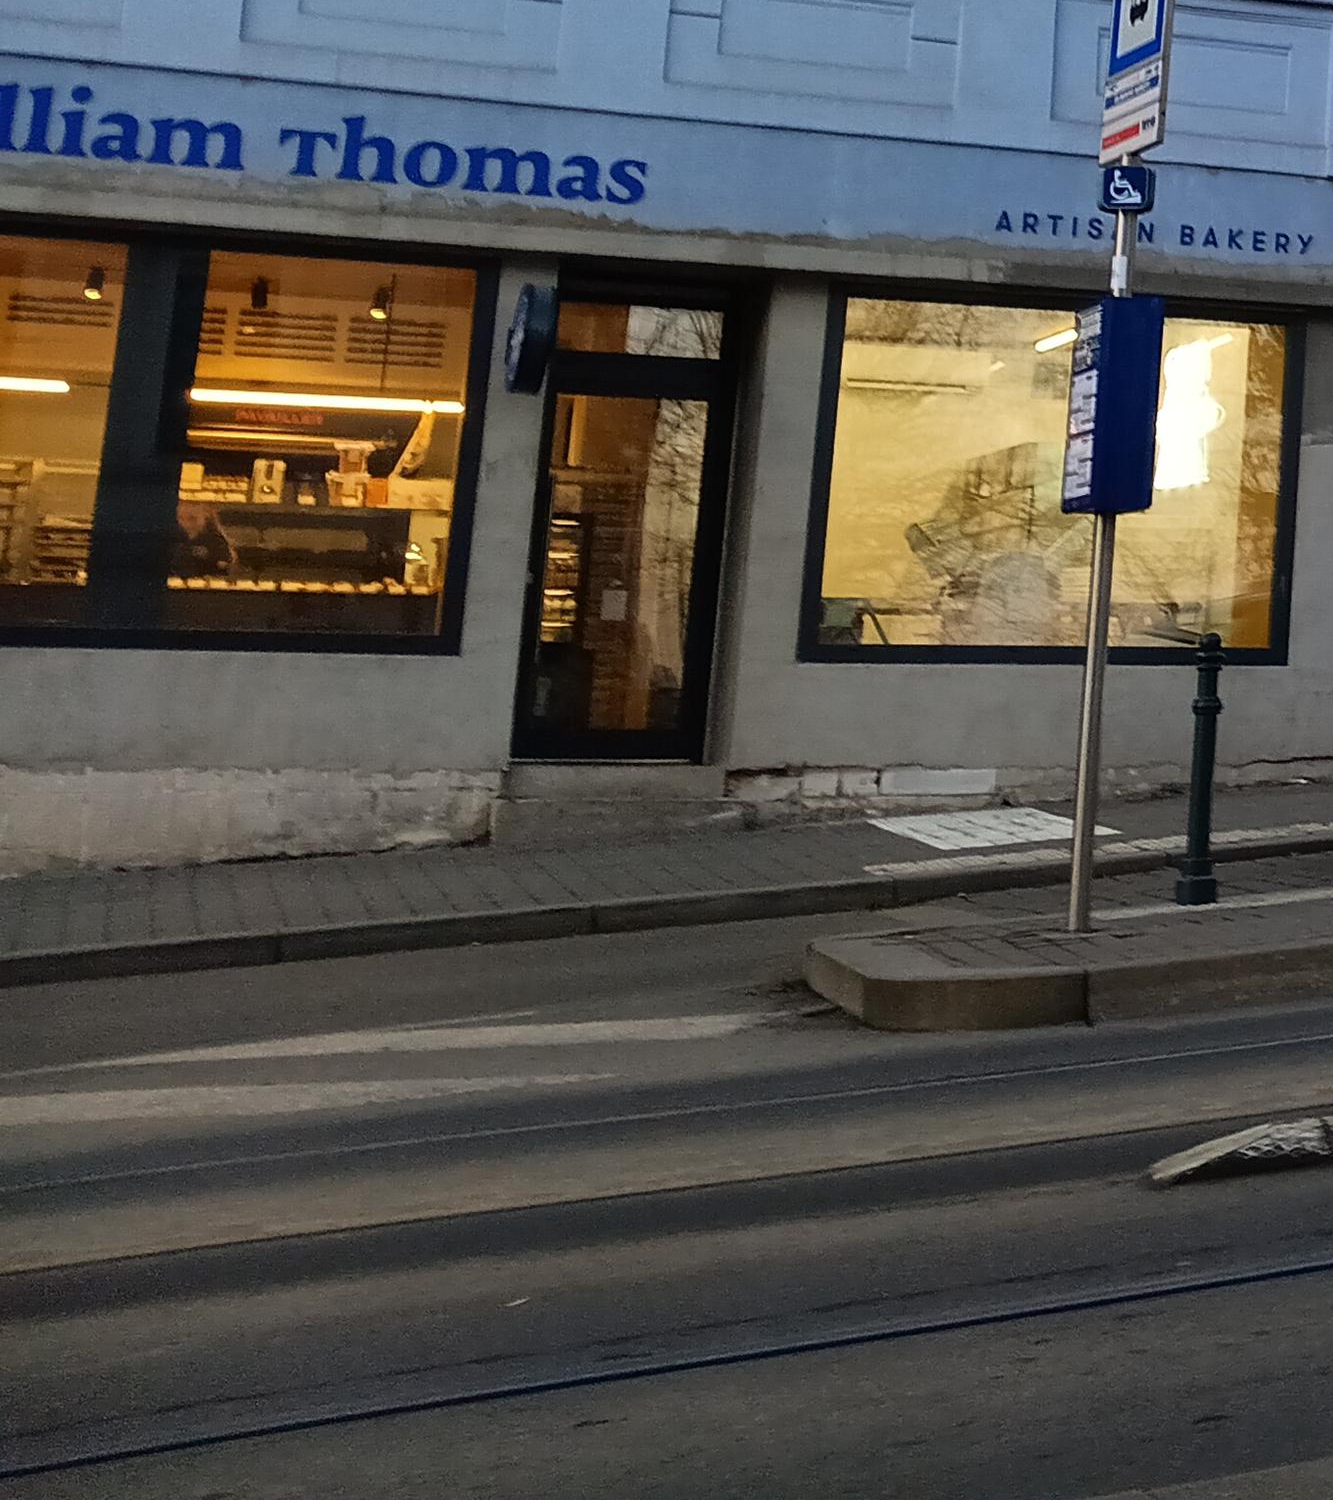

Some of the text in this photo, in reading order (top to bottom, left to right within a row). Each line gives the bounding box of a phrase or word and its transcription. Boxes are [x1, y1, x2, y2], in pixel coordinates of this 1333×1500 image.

[279, 115, 649, 205] Thomas
[995, 210, 1315, 255] ARTISN BAKERY
